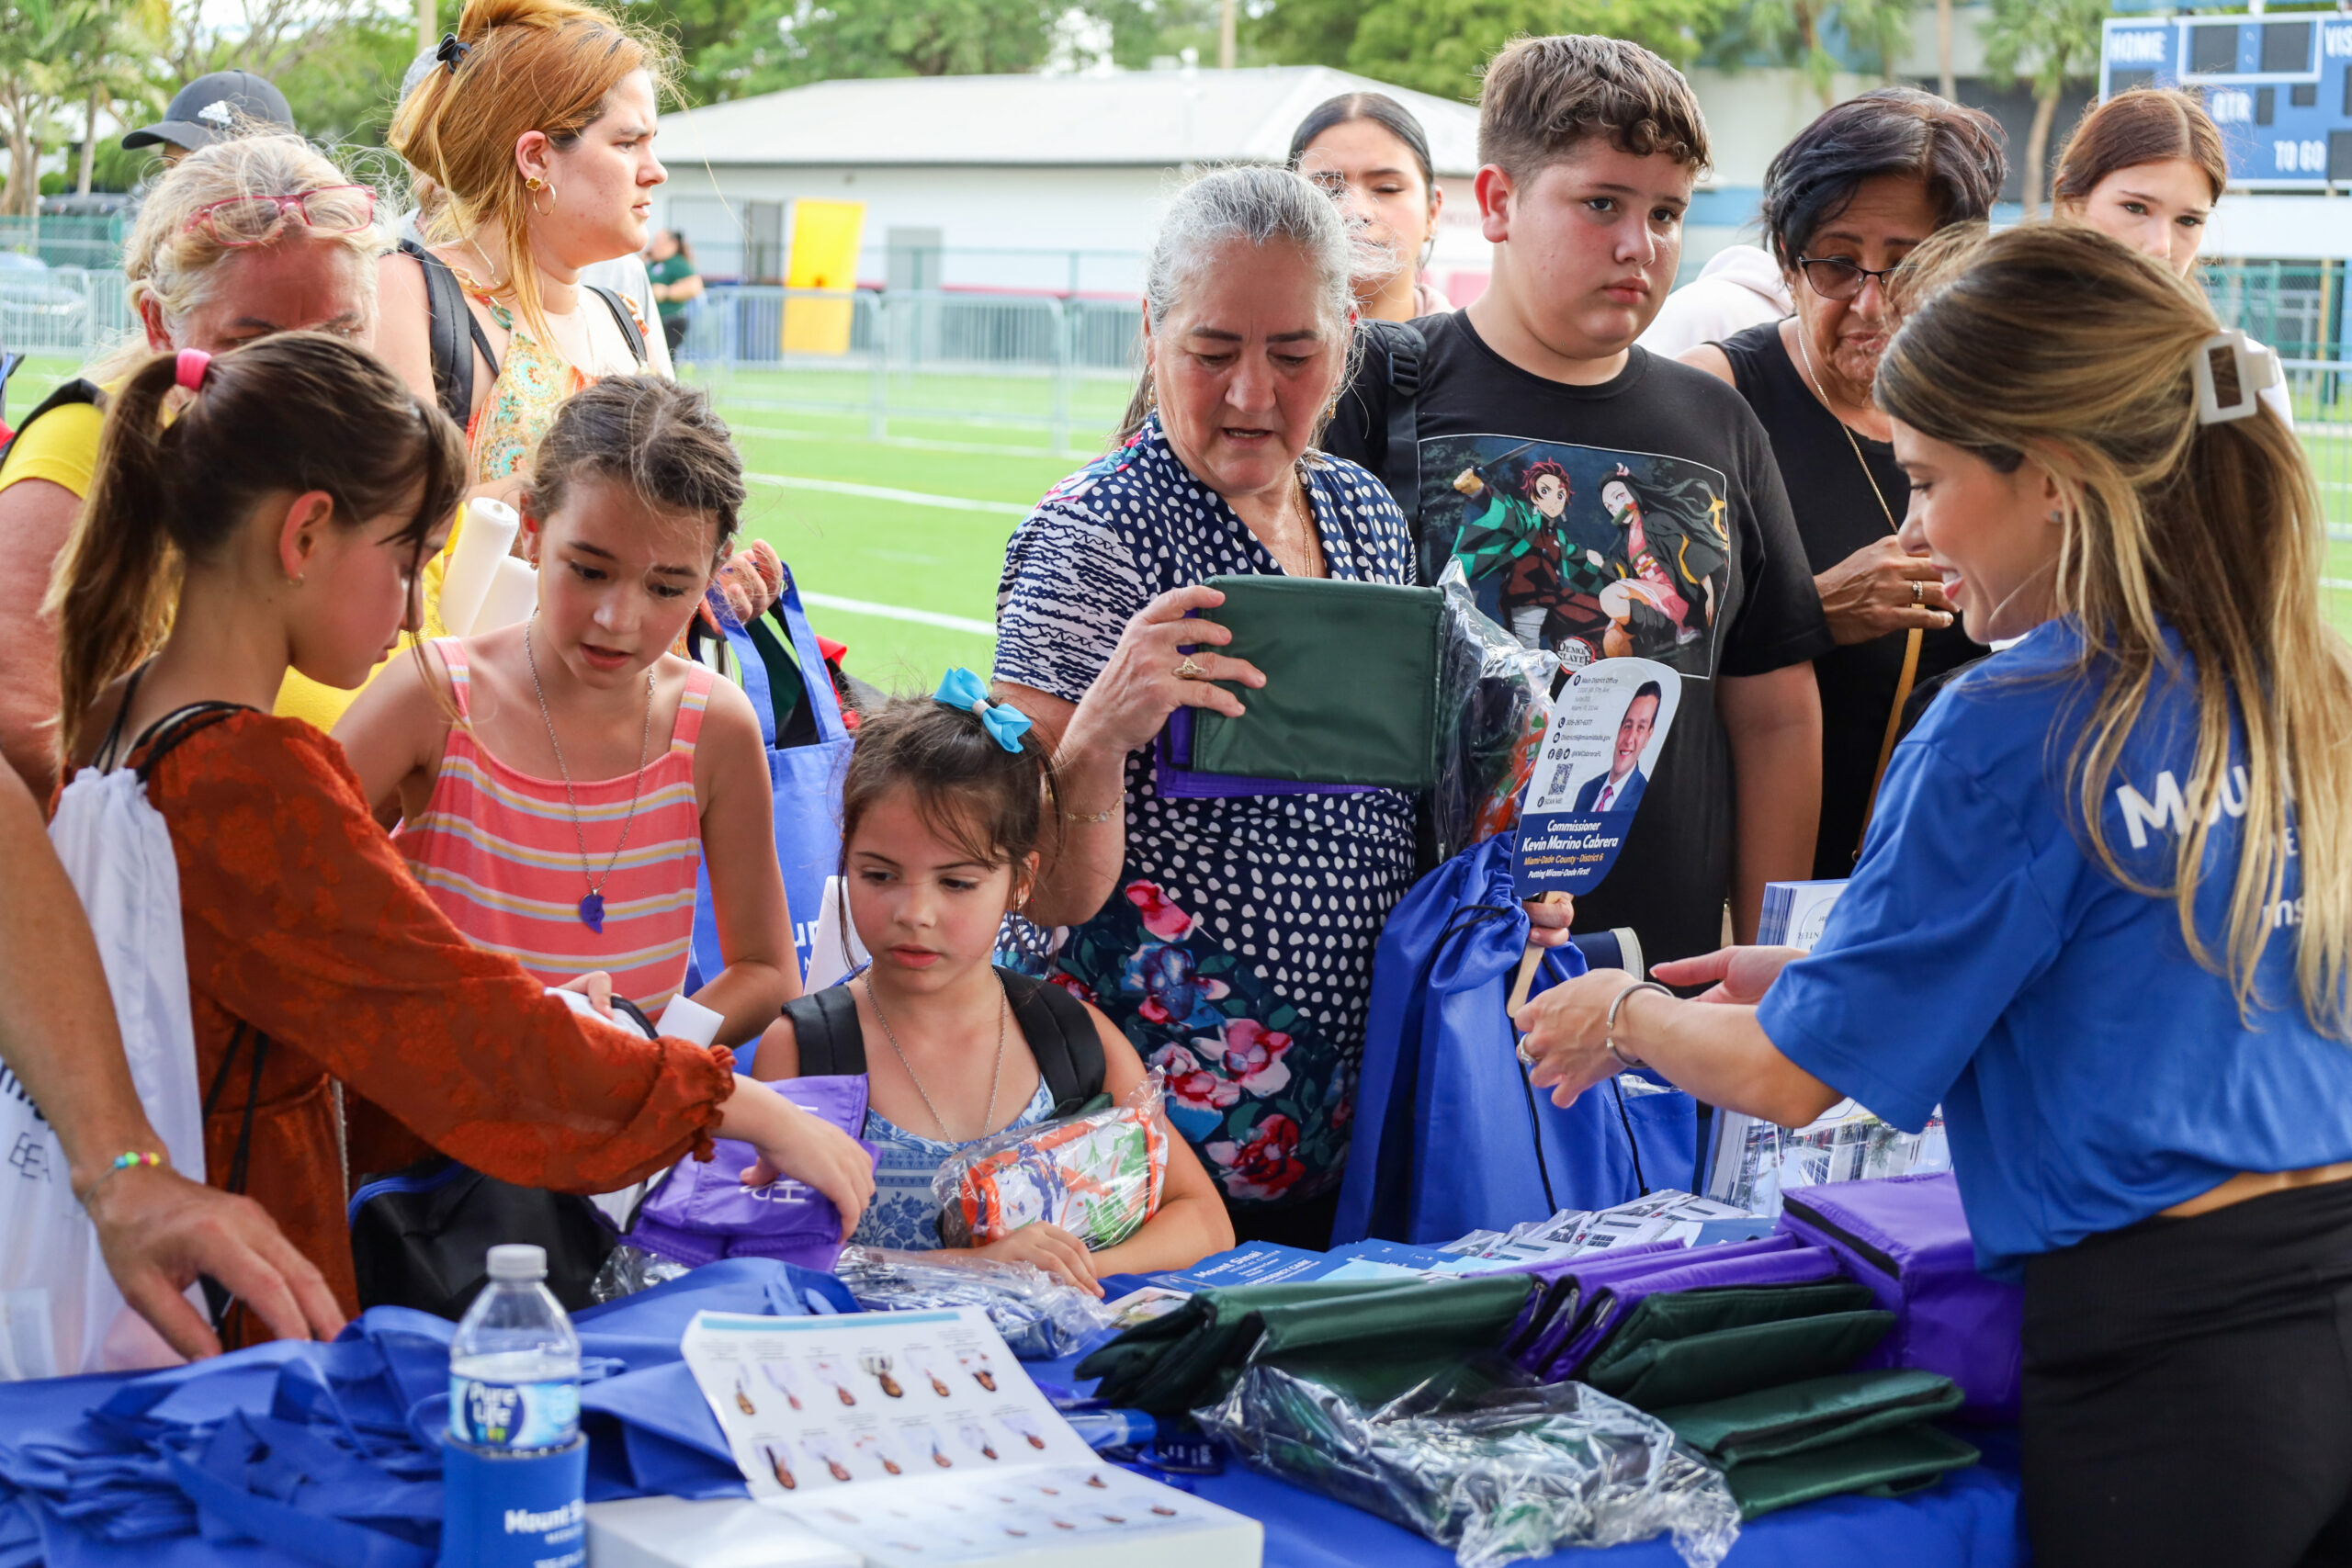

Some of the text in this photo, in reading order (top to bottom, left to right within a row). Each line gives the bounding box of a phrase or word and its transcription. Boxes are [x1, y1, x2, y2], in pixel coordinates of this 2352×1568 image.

[2108, 31, 2166, 62] HOME
[2211, 92, 2252, 123] QTR
[2274, 141, 2326, 172] TO GO
[1547, 819, 1601, 832] Commissioner
[1521, 833, 1619, 852] Kevin Marino Cabrera
[1524, 854, 1555, 865] Miami-Dade
[1555, 855, 1577, 865] County
[1579, 853, 1599, 863] District
[1600, 852, 1604, 862] 6
[1527, 870, 1545, 879] Putting
[1545, 868, 1577, 877] Miami-Dade
[1193, 1263, 1235, 1279] Mount
[1229, 1250, 1263, 1265] Sinai
[469, 1382, 516, 1407] Pure
[473, 1402, 512, 1427] Life
[504, 1505, 569, 1534] Mount
